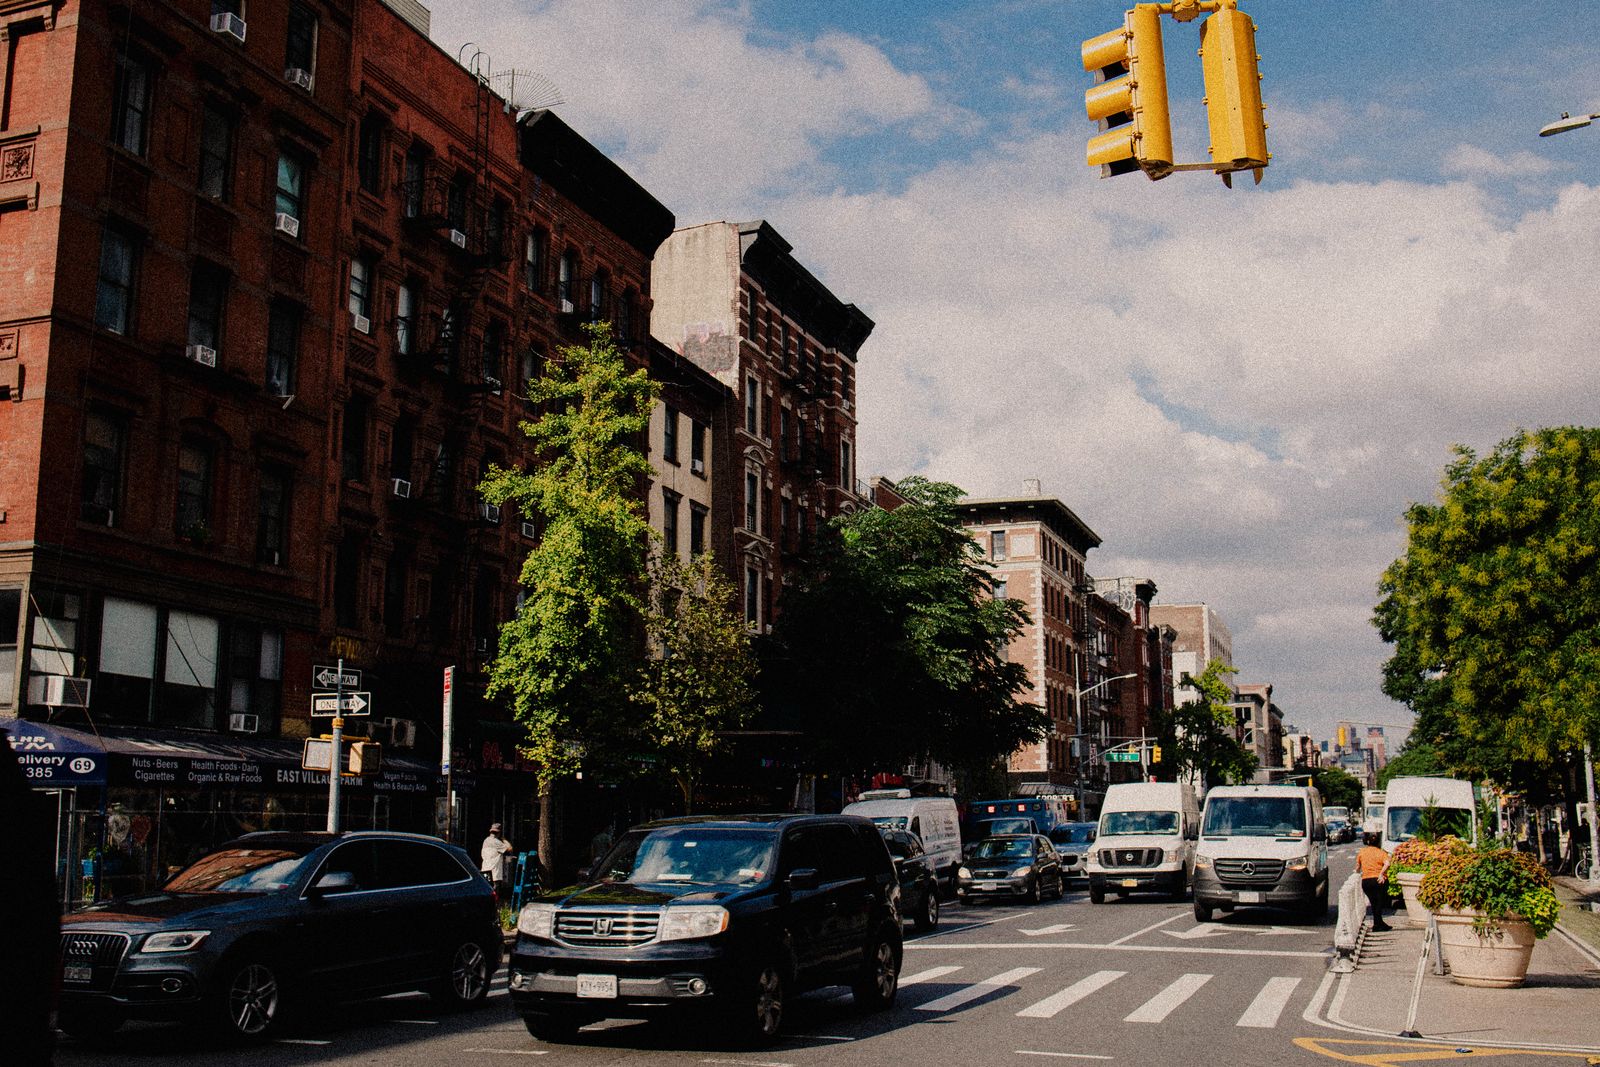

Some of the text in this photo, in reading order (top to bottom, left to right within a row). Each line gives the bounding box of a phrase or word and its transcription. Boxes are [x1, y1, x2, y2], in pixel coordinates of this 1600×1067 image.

[321, 673, 355, 684] ONE WAY
[320, 700, 361, 709] ONE WAY
[18, 755, 66, 767] elivery
[74, 761, 92, 771] 69
[132, 758, 179, 769] Nuts Beers
[26, 767, 54, 778] 385
[191, 760, 259, 774] Health Foods Dairy
[135, 770, 175, 782] Cigarettes
[188, 772, 263, 783] Organic & Raw Foods
[276, 769, 300, 783] EAST
[302, 771, 331, 785] VILLA
[397, 782, 415, 792] Beauty
